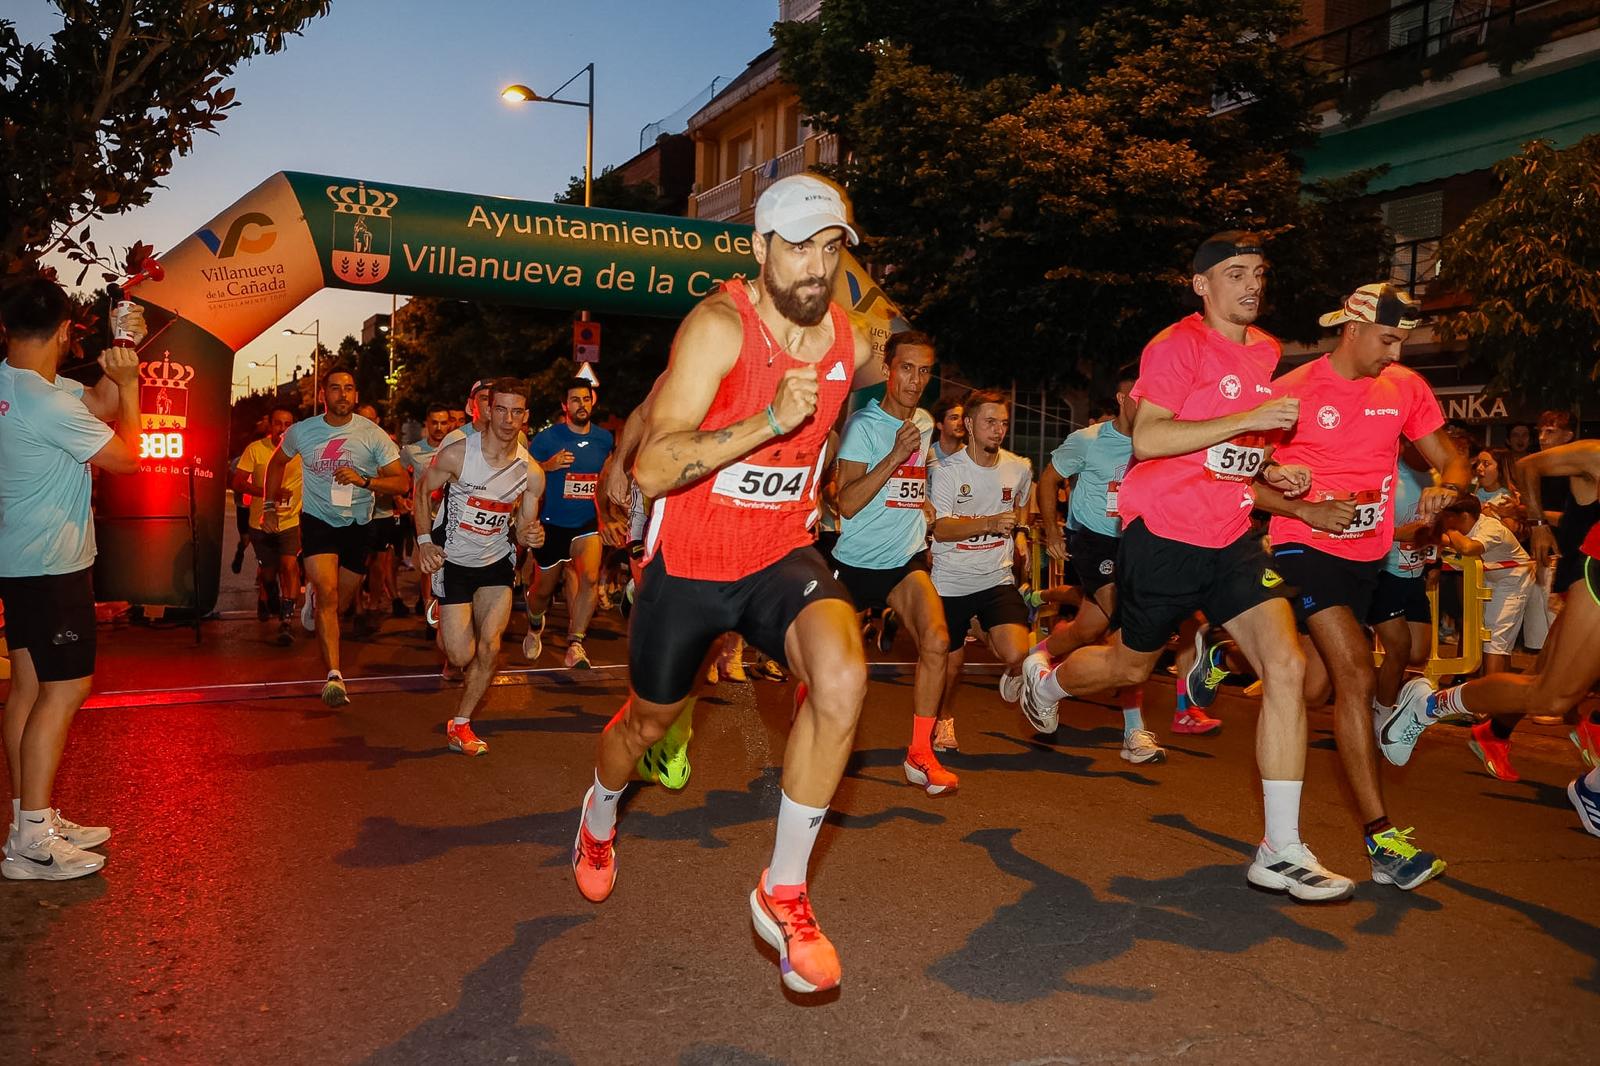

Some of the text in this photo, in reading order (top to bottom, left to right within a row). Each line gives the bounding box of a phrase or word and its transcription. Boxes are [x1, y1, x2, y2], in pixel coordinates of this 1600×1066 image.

[466, 204, 751, 256] Ayuntamiento de
[200, 263, 285, 283] Villanueva
[401, 242, 582, 288] Villanueva
[595, 262, 637, 293] de
[647, 265, 675, 295] la
[206, 276, 286, 299] de la Cañada
[1220, 447, 1260, 473] 519
[155, 465, 168, 474] de
[170, 465, 180, 474] la
[182, 466, 214, 479] Cñada
[572, 482, 596, 494] 548
[738, 470, 803, 497] 504
[899, 482, 925, 499] 554
[473, 511, 506, 528] 546
[1351, 507, 1375, 528] 43
